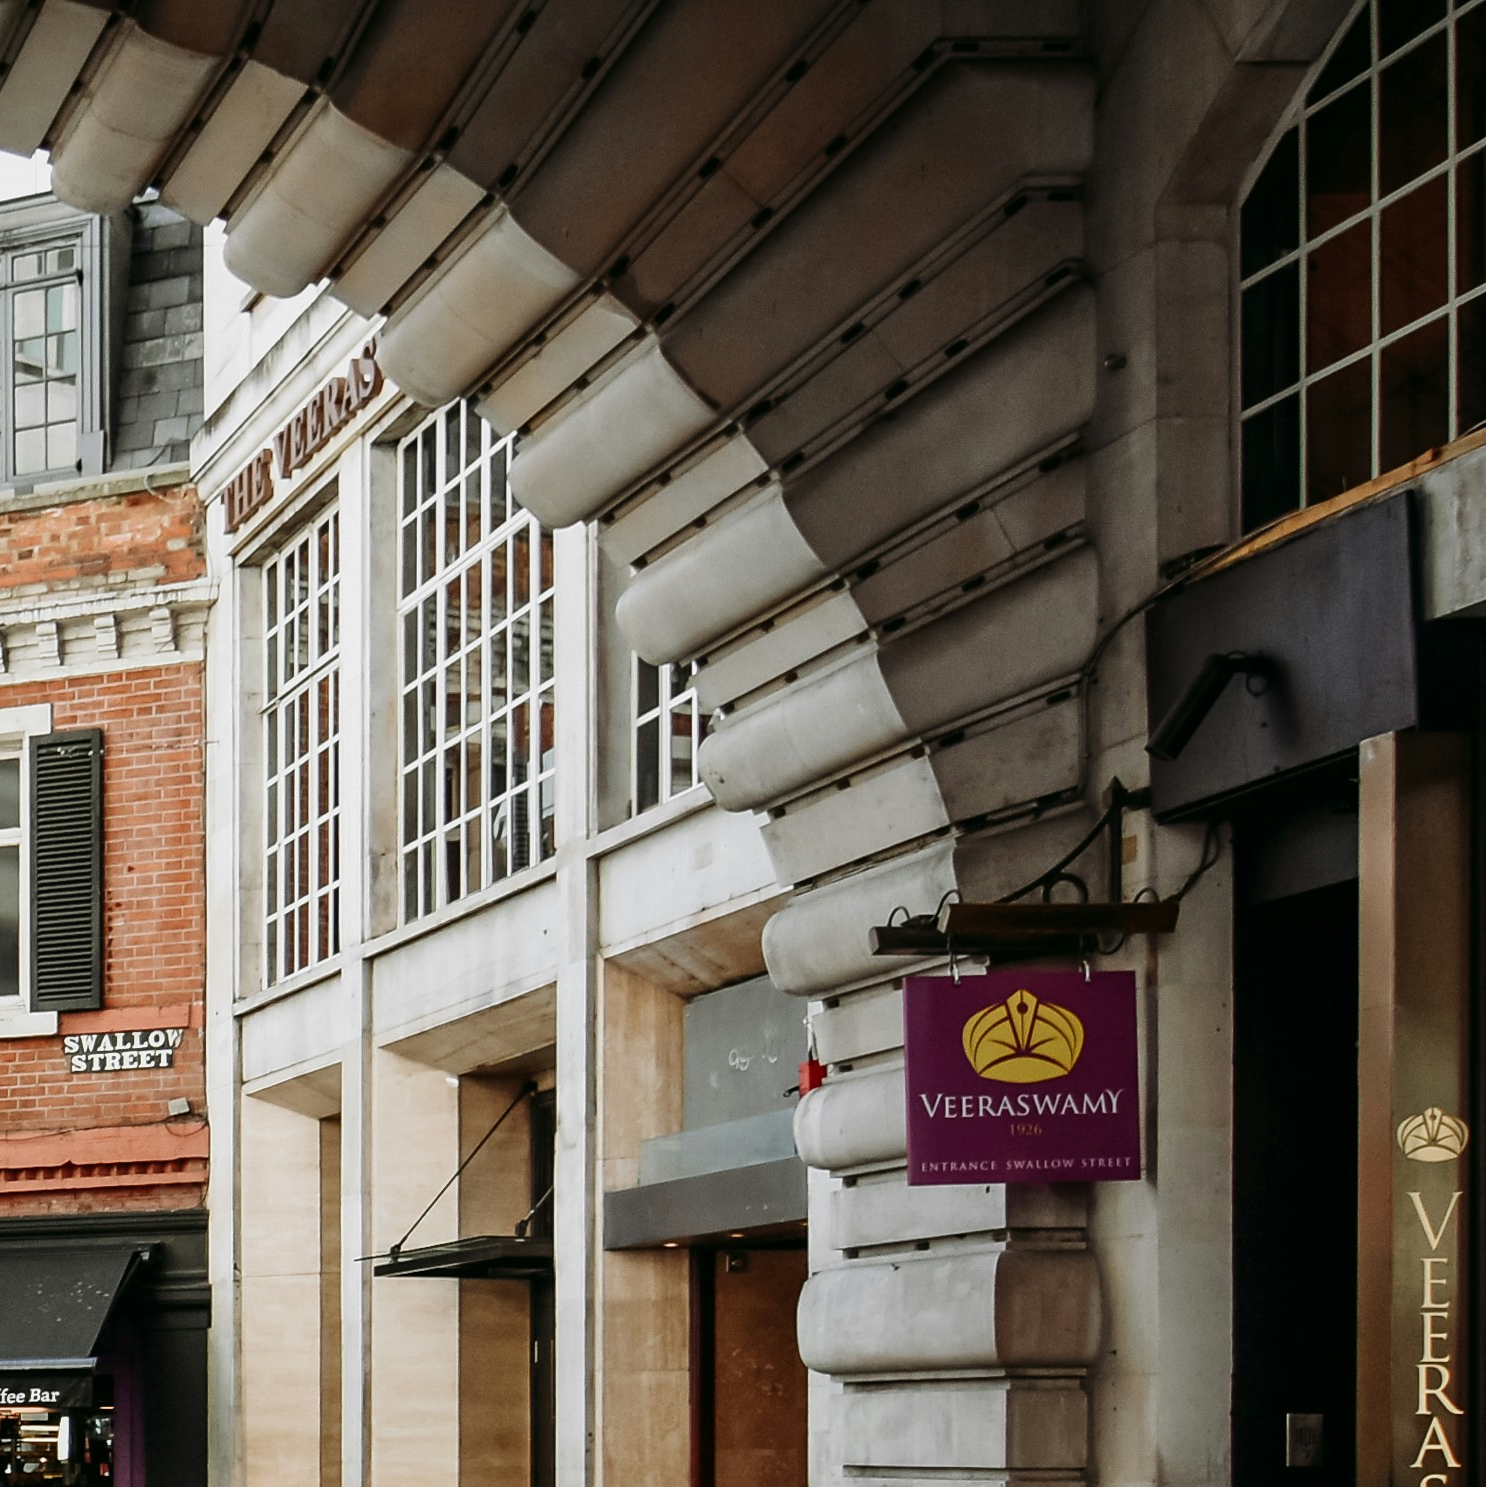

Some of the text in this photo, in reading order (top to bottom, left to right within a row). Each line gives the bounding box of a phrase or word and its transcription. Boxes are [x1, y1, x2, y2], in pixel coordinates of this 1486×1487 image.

[220, 334, 386, 535] THE VEERAS
[63, 1028, 183, 1054] SWALLOW
[71, 1049, 173, 1072] STREET
[920, 1089, 1124, 1118] VEERASWAMY
[1009, 1123, 1043, 1136] 1926
[921, 1156, 1132, 1173] ENTRANCE SWALLOW STREET
[28, 1388, 60, 1403] Bar
